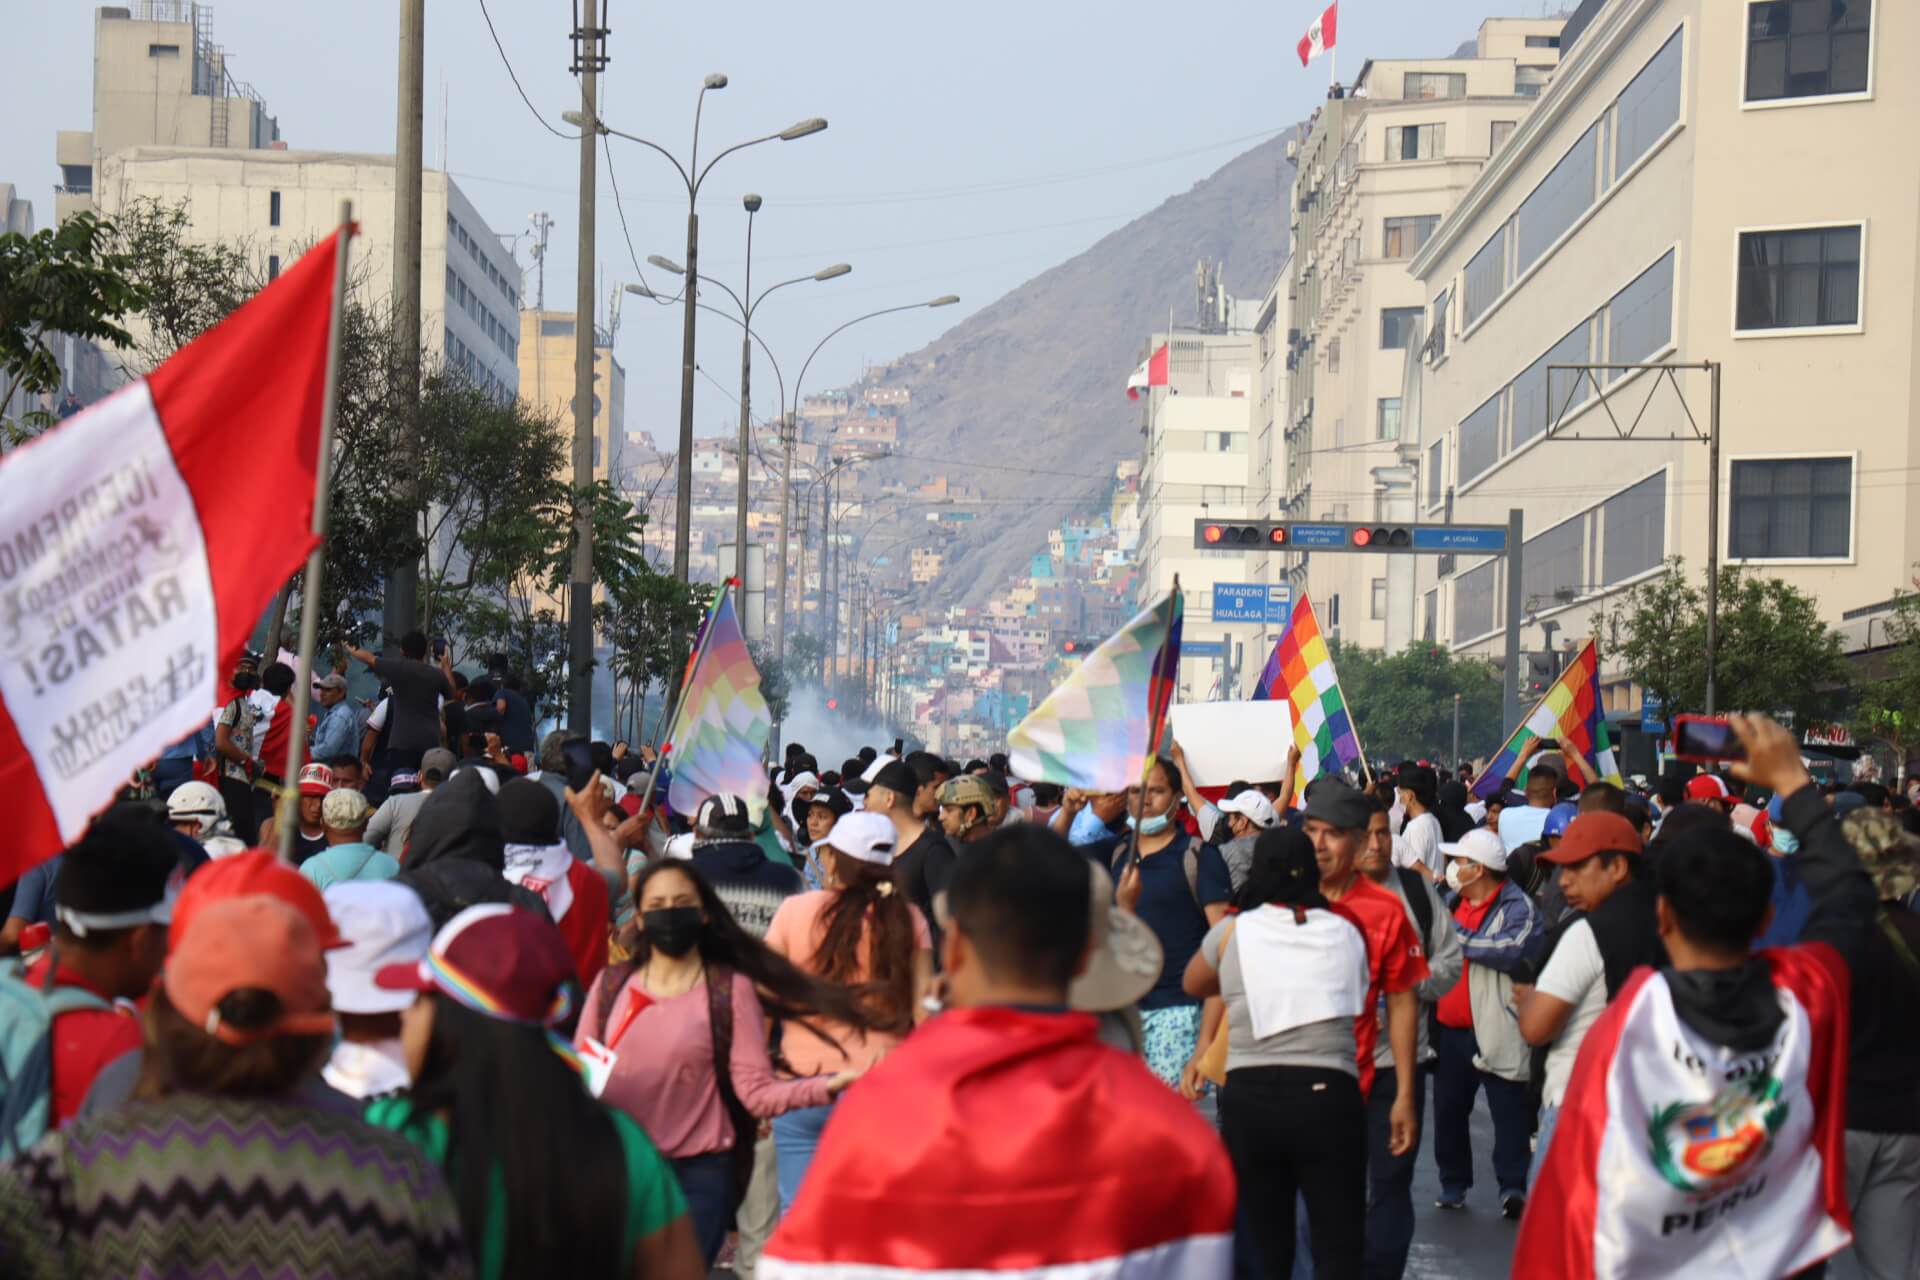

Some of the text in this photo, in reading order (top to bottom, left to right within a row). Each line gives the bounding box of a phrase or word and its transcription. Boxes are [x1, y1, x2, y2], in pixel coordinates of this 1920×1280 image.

[1273, 530, 1283, 542] 10
[1217, 587, 1263, 598] PARADERO
[1235, 598, 1244, 608] B
[1216, 609, 1262, 618] HUALLAGA
[1661, 1174, 1768, 1237] PERU
